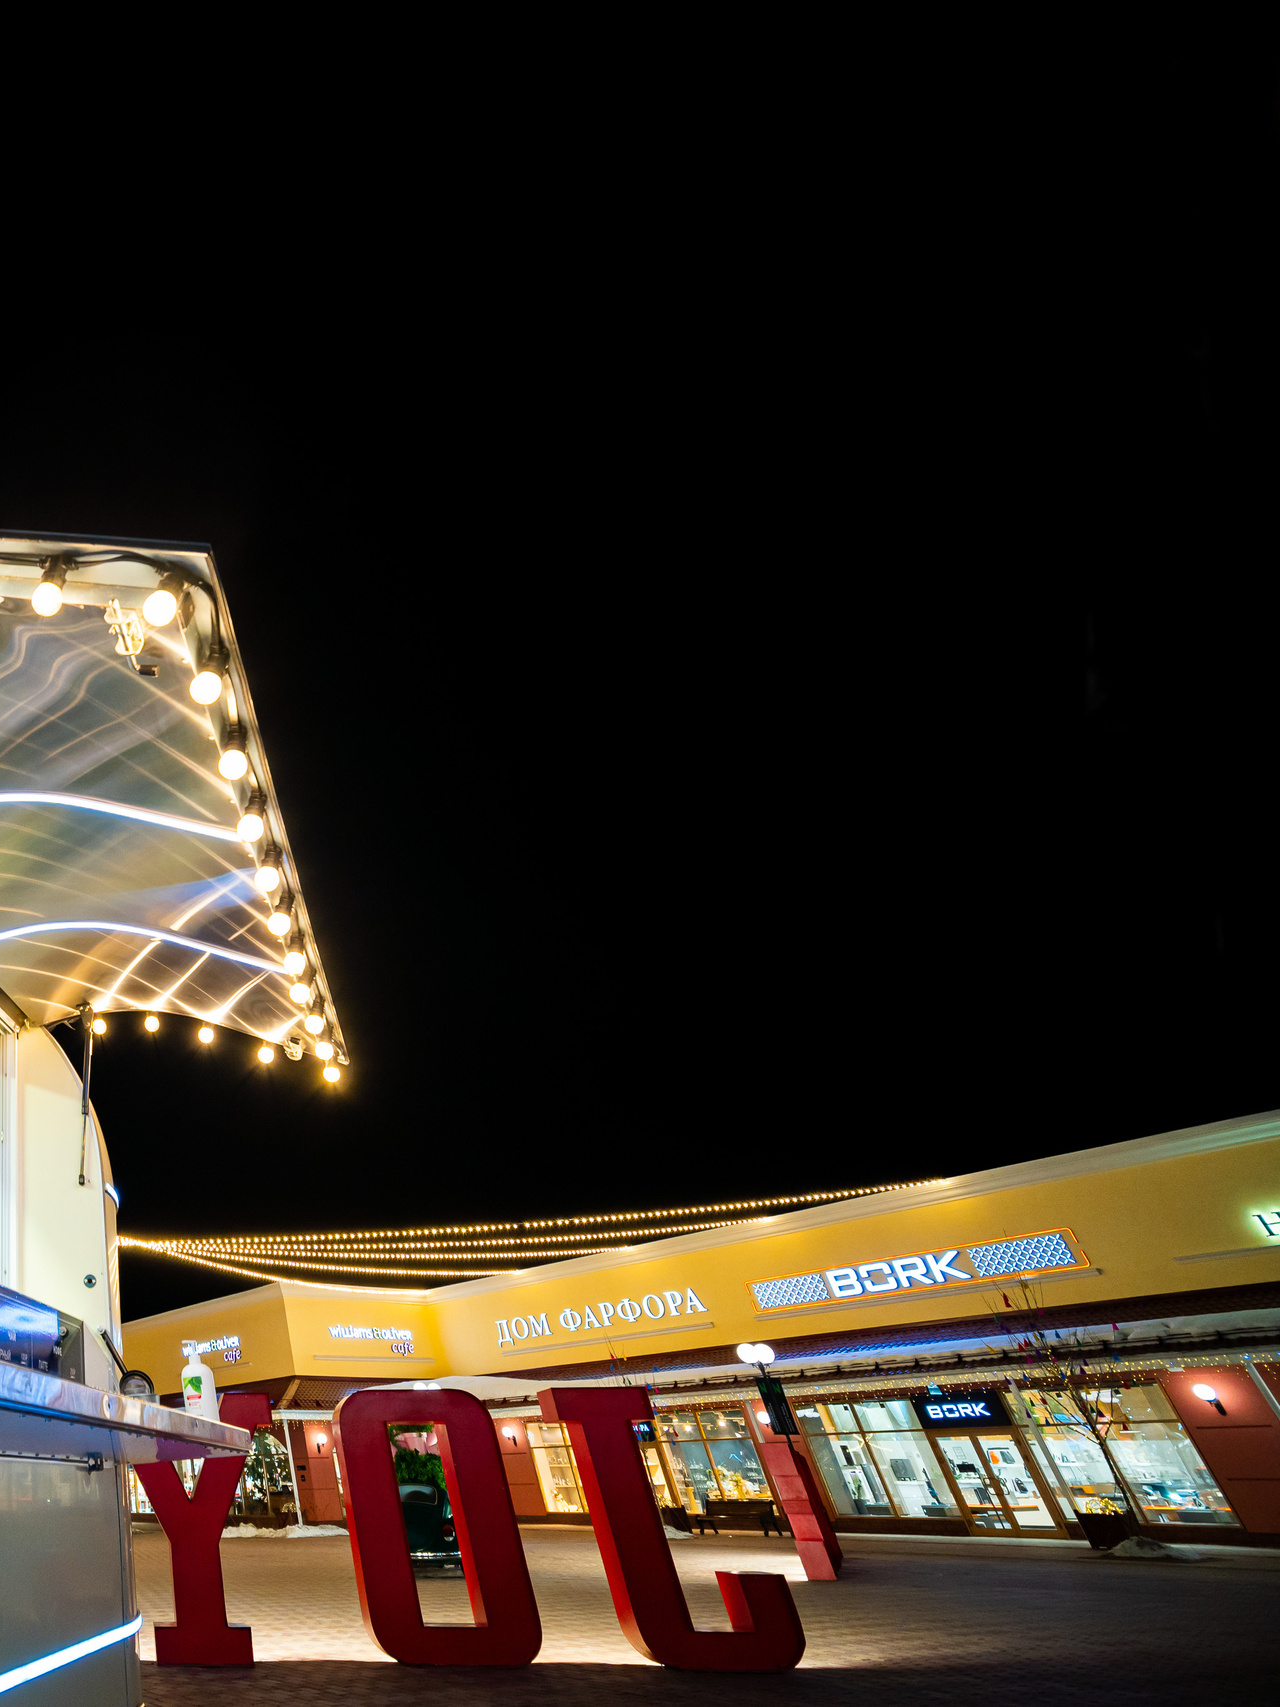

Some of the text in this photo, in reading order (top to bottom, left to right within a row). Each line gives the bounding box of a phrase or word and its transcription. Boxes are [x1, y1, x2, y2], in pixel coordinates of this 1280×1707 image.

[826, 1250, 972, 1298] BORK
[494, 1287, 708, 1348] ДОМ ФАРФОРА
[223, 1348, 242, 1363] cafe
[391, 1341, 415, 1356] cafe
[925, 1402, 991, 1419] BORK
